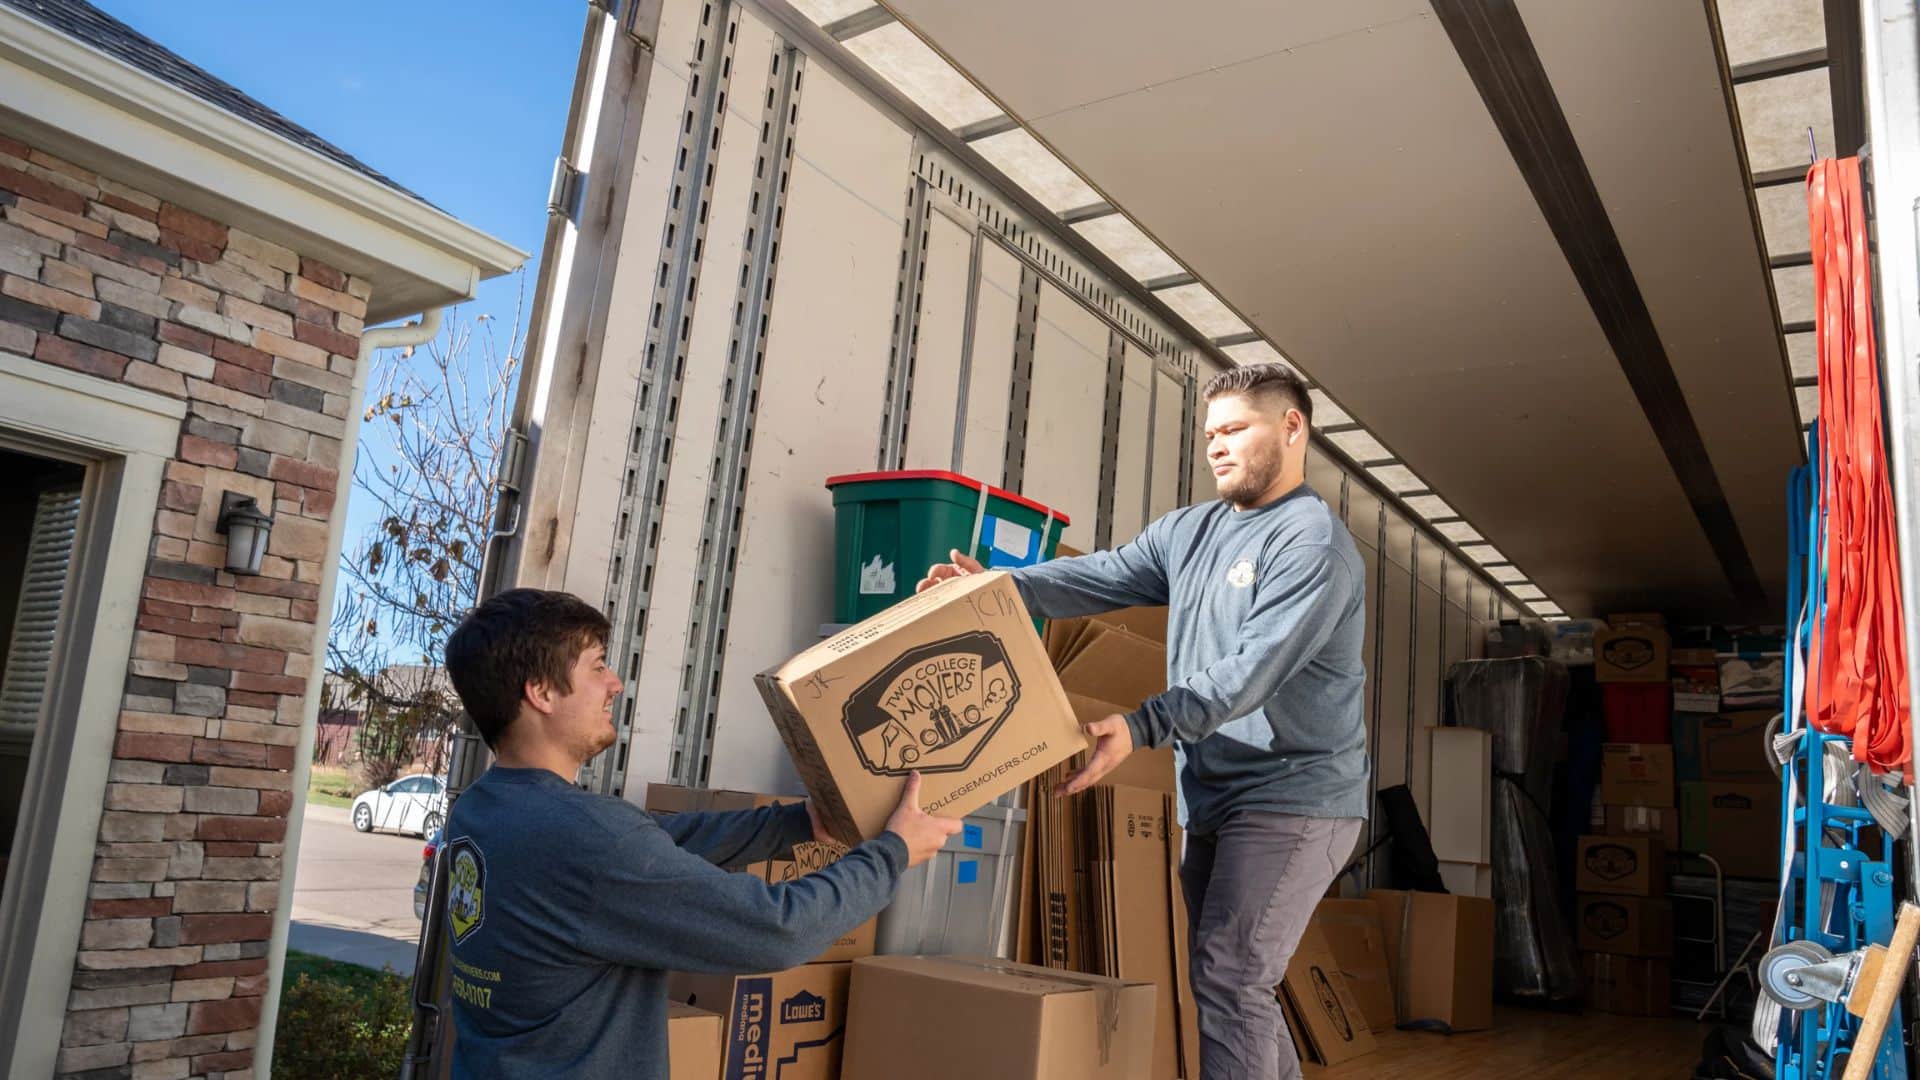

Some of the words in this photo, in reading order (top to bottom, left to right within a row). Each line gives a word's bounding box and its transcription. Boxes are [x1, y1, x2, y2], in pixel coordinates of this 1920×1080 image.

[885, 678, 913, 708] TWO
[915, 657, 977, 681] COLLEGE
[898, 671, 976, 721] MOVERS
[784, 1002, 822, 1021] LOWE'S
